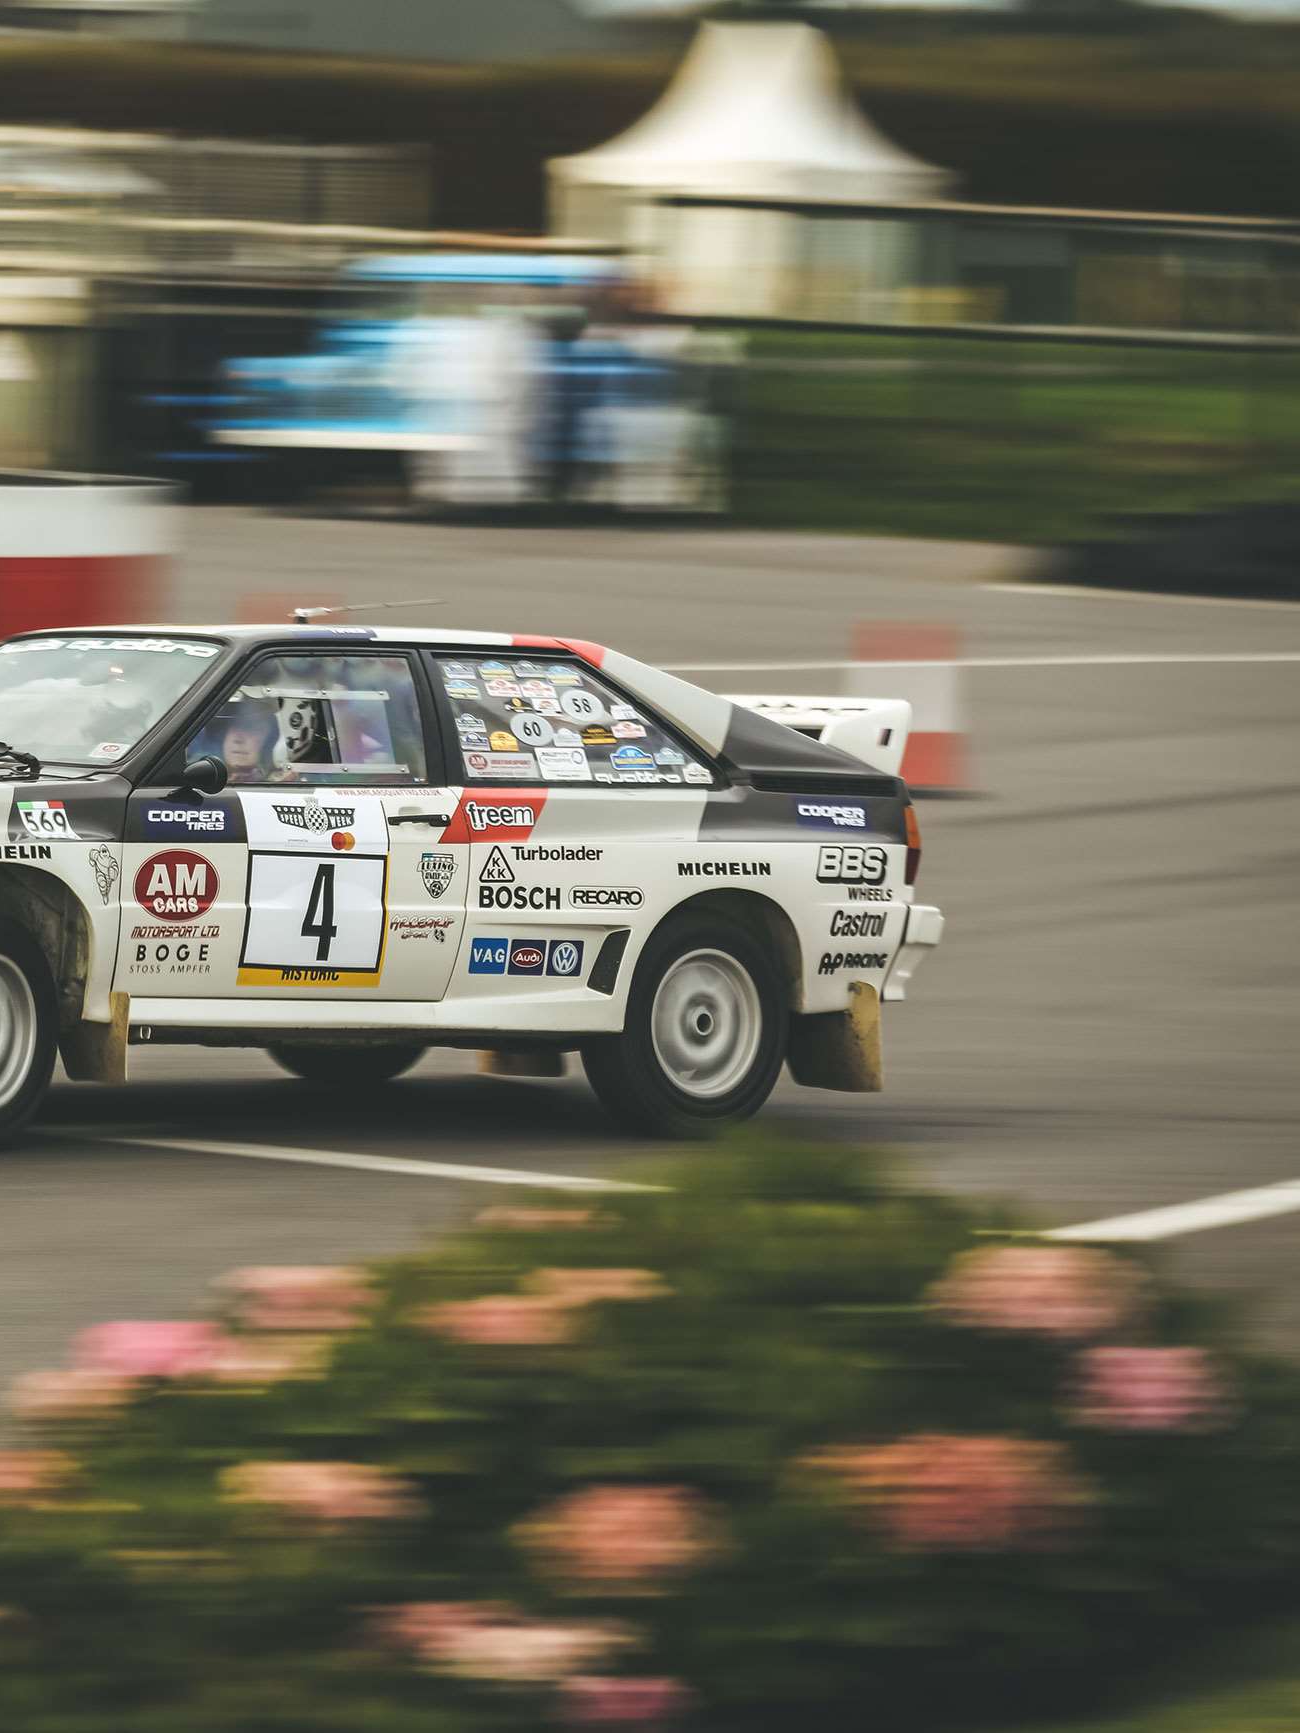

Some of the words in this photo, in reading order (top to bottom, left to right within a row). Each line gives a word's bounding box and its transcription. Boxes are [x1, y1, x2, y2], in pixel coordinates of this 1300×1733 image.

[572, 698, 592, 713] 58
[523, 721, 541, 737] 60
[595, 771, 681, 784] quattro
[147, 810, 225, 823] COOPER
[467, 802, 532, 828] freem
[798, 804, 865, 819] COOPER
[24, 810, 69, 833] 569
[186, 821, 225, 831] TIRES
[279, 813, 304, 827] SPEED
[329, 815, 353, 828] WEEK
[832, 817, 866, 827] TIRES
[510, 846, 604, 861] Turbolader
[491, 857, 501, 868] K
[677, 862, 771, 876] MICHELIN
[816, 846, 888, 886] BBS
[146, 863, 207, 896] AM
[478, 885, 561, 910] BOSCH
[572, 890, 643, 906] RECARO
[848, 887, 893, 901] WHEELS
[152, 898, 199, 913] CARS
[301, 863, 337, 962] 4
[830, 909, 888, 937] Castrol
[131, 925, 200, 938] MOTORSPORT
[135, 944, 209, 962] BOGE
[515, 952, 540, 962] Audi
[129, 964, 161, 974] STOSS
[169, 964, 211, 974] AMPFER
